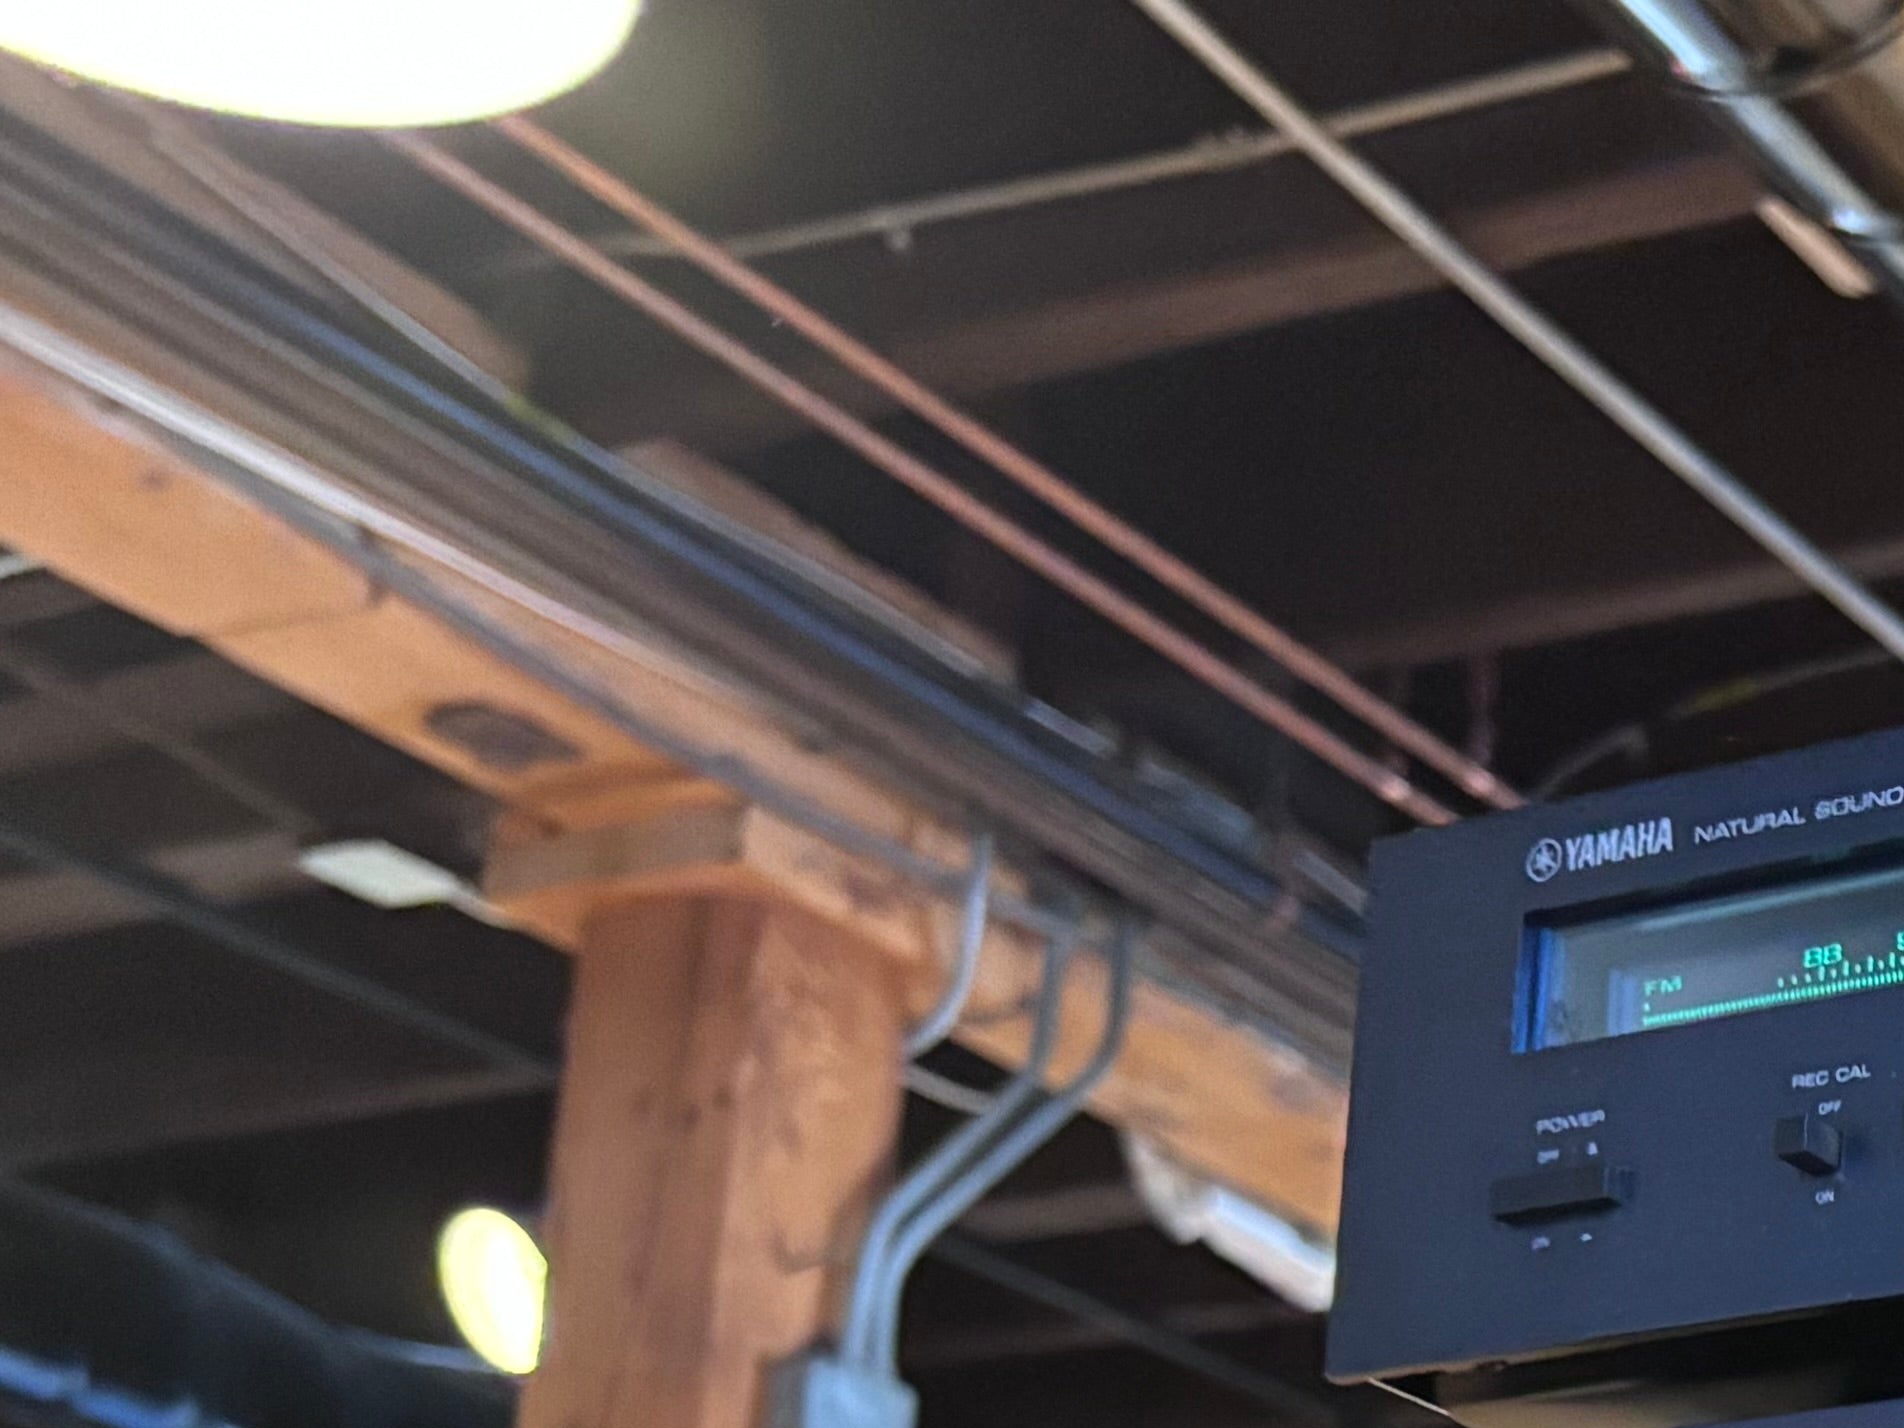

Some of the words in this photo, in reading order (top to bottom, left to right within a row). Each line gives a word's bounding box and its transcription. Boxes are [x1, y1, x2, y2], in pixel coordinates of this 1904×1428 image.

[1565, 817, 1674, 872] YAMAHA
[1695, 806, 1805, 845] NATURAL
[1815, 786, 1904, 820] SOUND
[1644, 976, 1681, 995] FM
[1804, 944, 1843, 968] 88
[1792, 1069, 1829, 1090] REC
[1835, 1063, 1870, 1083] CAL
